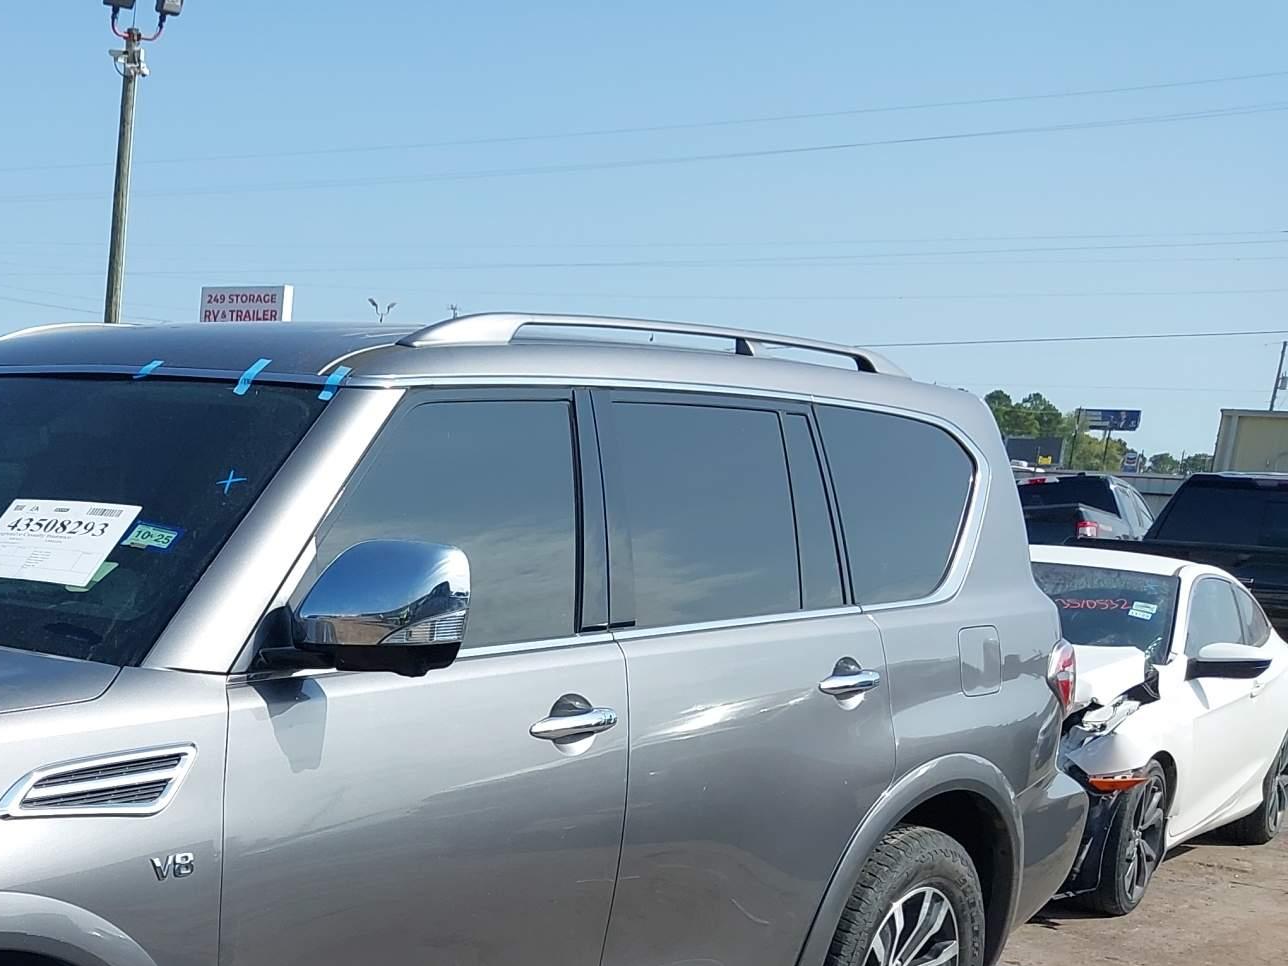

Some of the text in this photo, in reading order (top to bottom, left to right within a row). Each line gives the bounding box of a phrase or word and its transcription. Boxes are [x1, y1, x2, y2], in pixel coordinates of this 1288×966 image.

[207, 293, 277, 304] 249 STORAGE
[204, 310, 219, 322] RV
[229, 309, 278, 322] TRAILER
[7, 516, 109, 538] 43508293
[149, 852, 195, 881] V8
